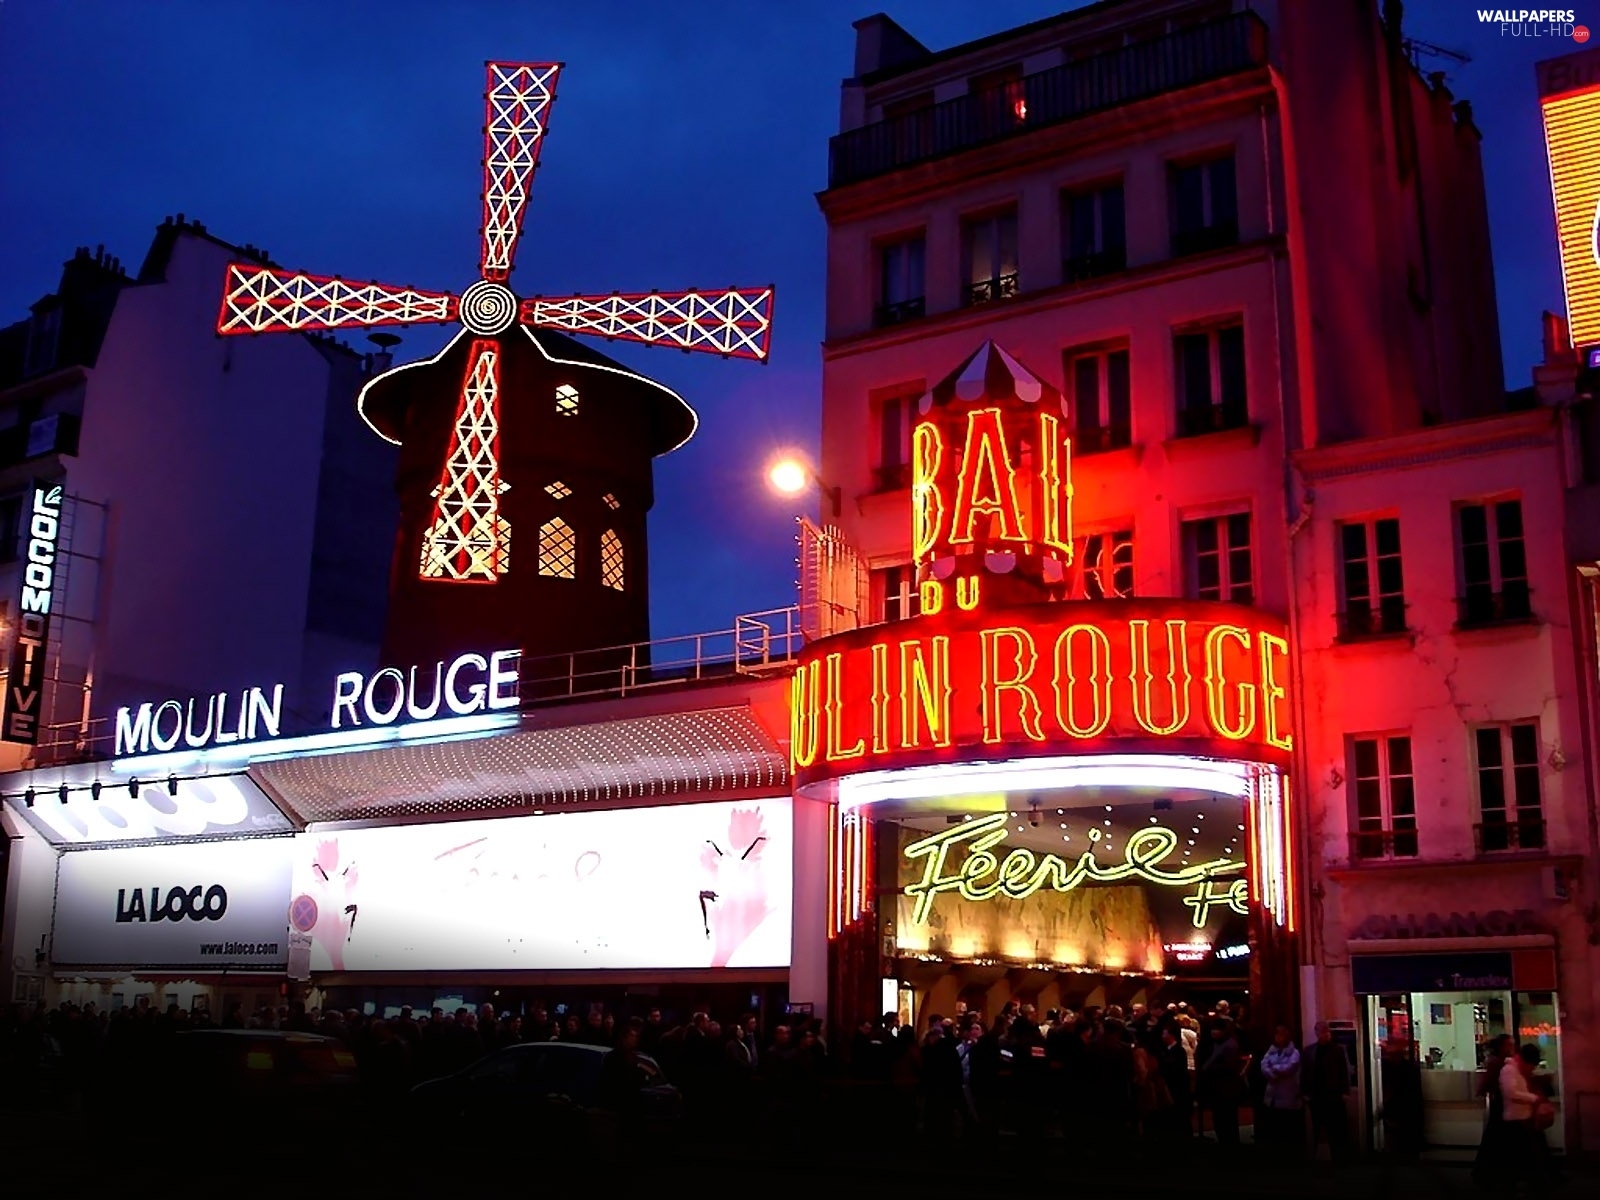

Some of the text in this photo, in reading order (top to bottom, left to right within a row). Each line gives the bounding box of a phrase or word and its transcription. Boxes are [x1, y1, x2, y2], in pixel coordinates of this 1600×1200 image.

[912, 407, 1074, 567] BAL
[9, 488, 59, 738] LOCOMOTIVE
[920, 575, 980, 615] DU
[114, 649, 523, 755] MOULIN ROUGE
[790, 620, 1293, 775] ULIN ROUGE
[115, 884, 228, 923] LA LOCO
[200, 942, 279, 955] www.laloco.com
[1451, 973, 1510, 988] Travelex
